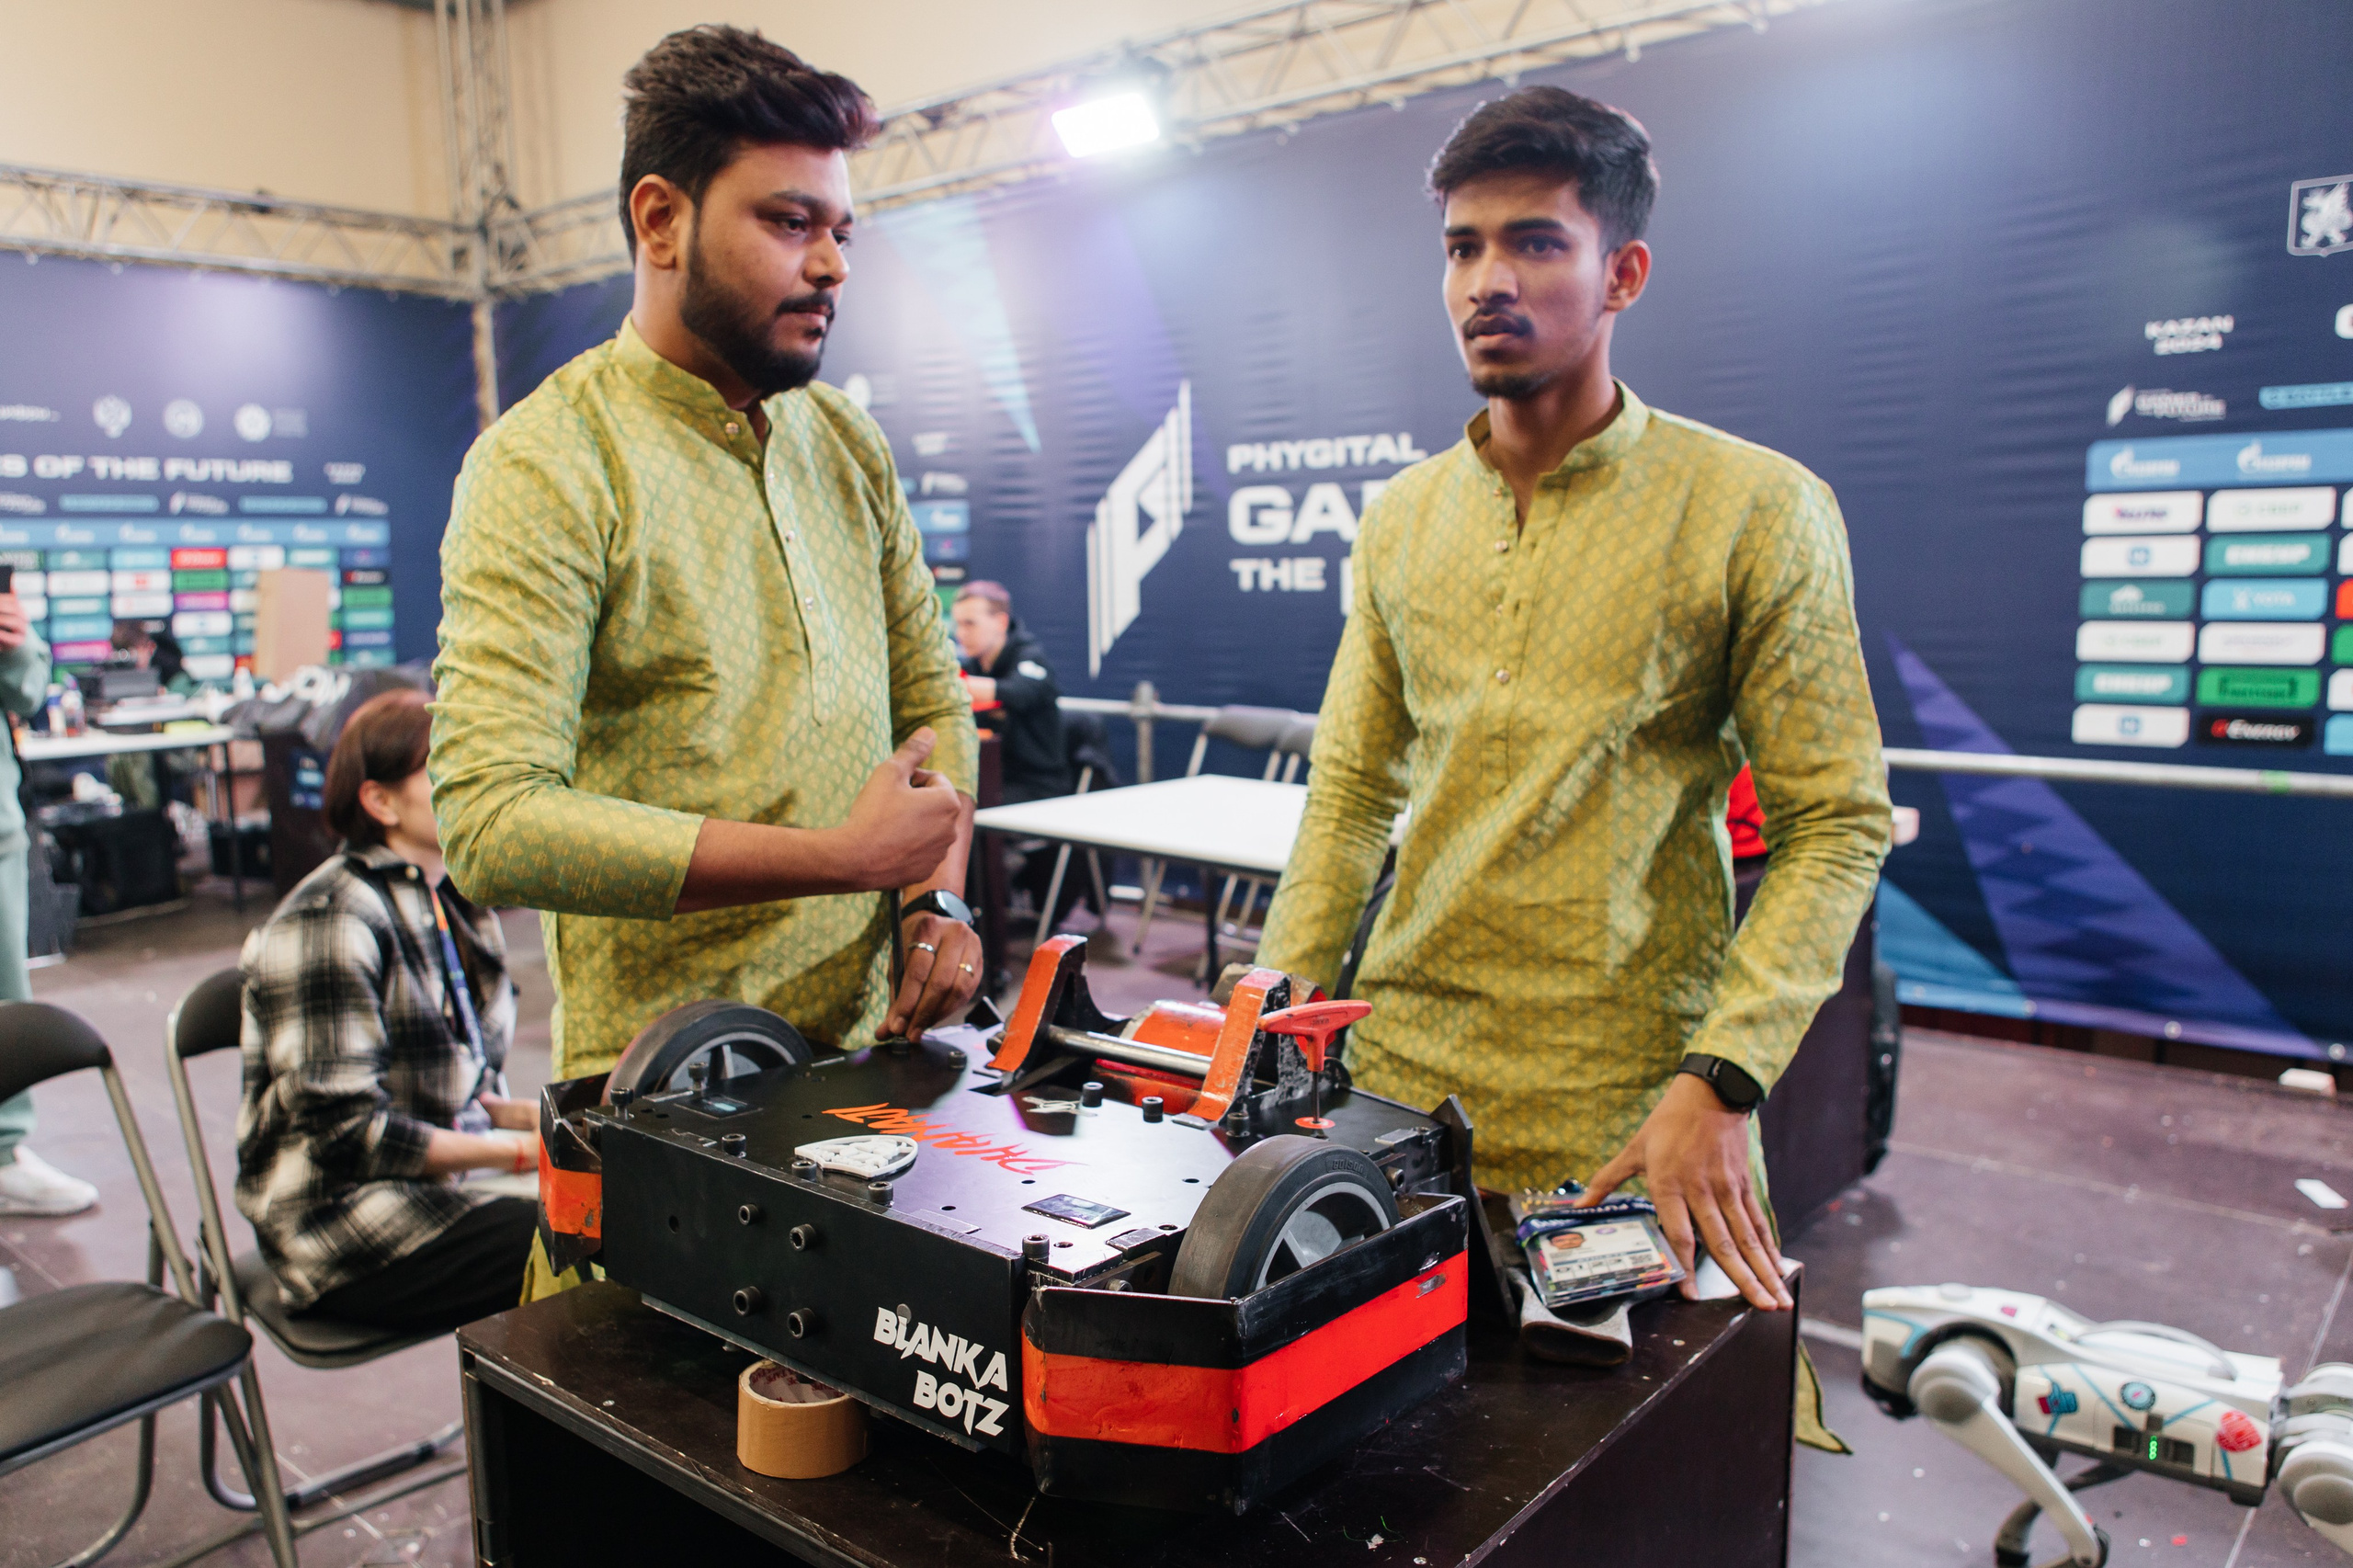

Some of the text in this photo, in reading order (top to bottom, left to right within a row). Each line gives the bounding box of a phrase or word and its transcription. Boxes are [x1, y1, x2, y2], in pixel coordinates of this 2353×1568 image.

[2145, 315, 2234, 339] KAZAN
[33, 454, 85, 479] OF
[87, 457, 161, 481] THE
[164, 459, 293, 483] FUTURE
[1227, 432, 1427, 473] PHYGITAL
[1228, 480, 1389, 545] GA
[1230, 558, 1325, 591] THE
[874, 1306, 1008, 1392] BLANKA
[914, 1369, 1009, 1436] BOTZ
